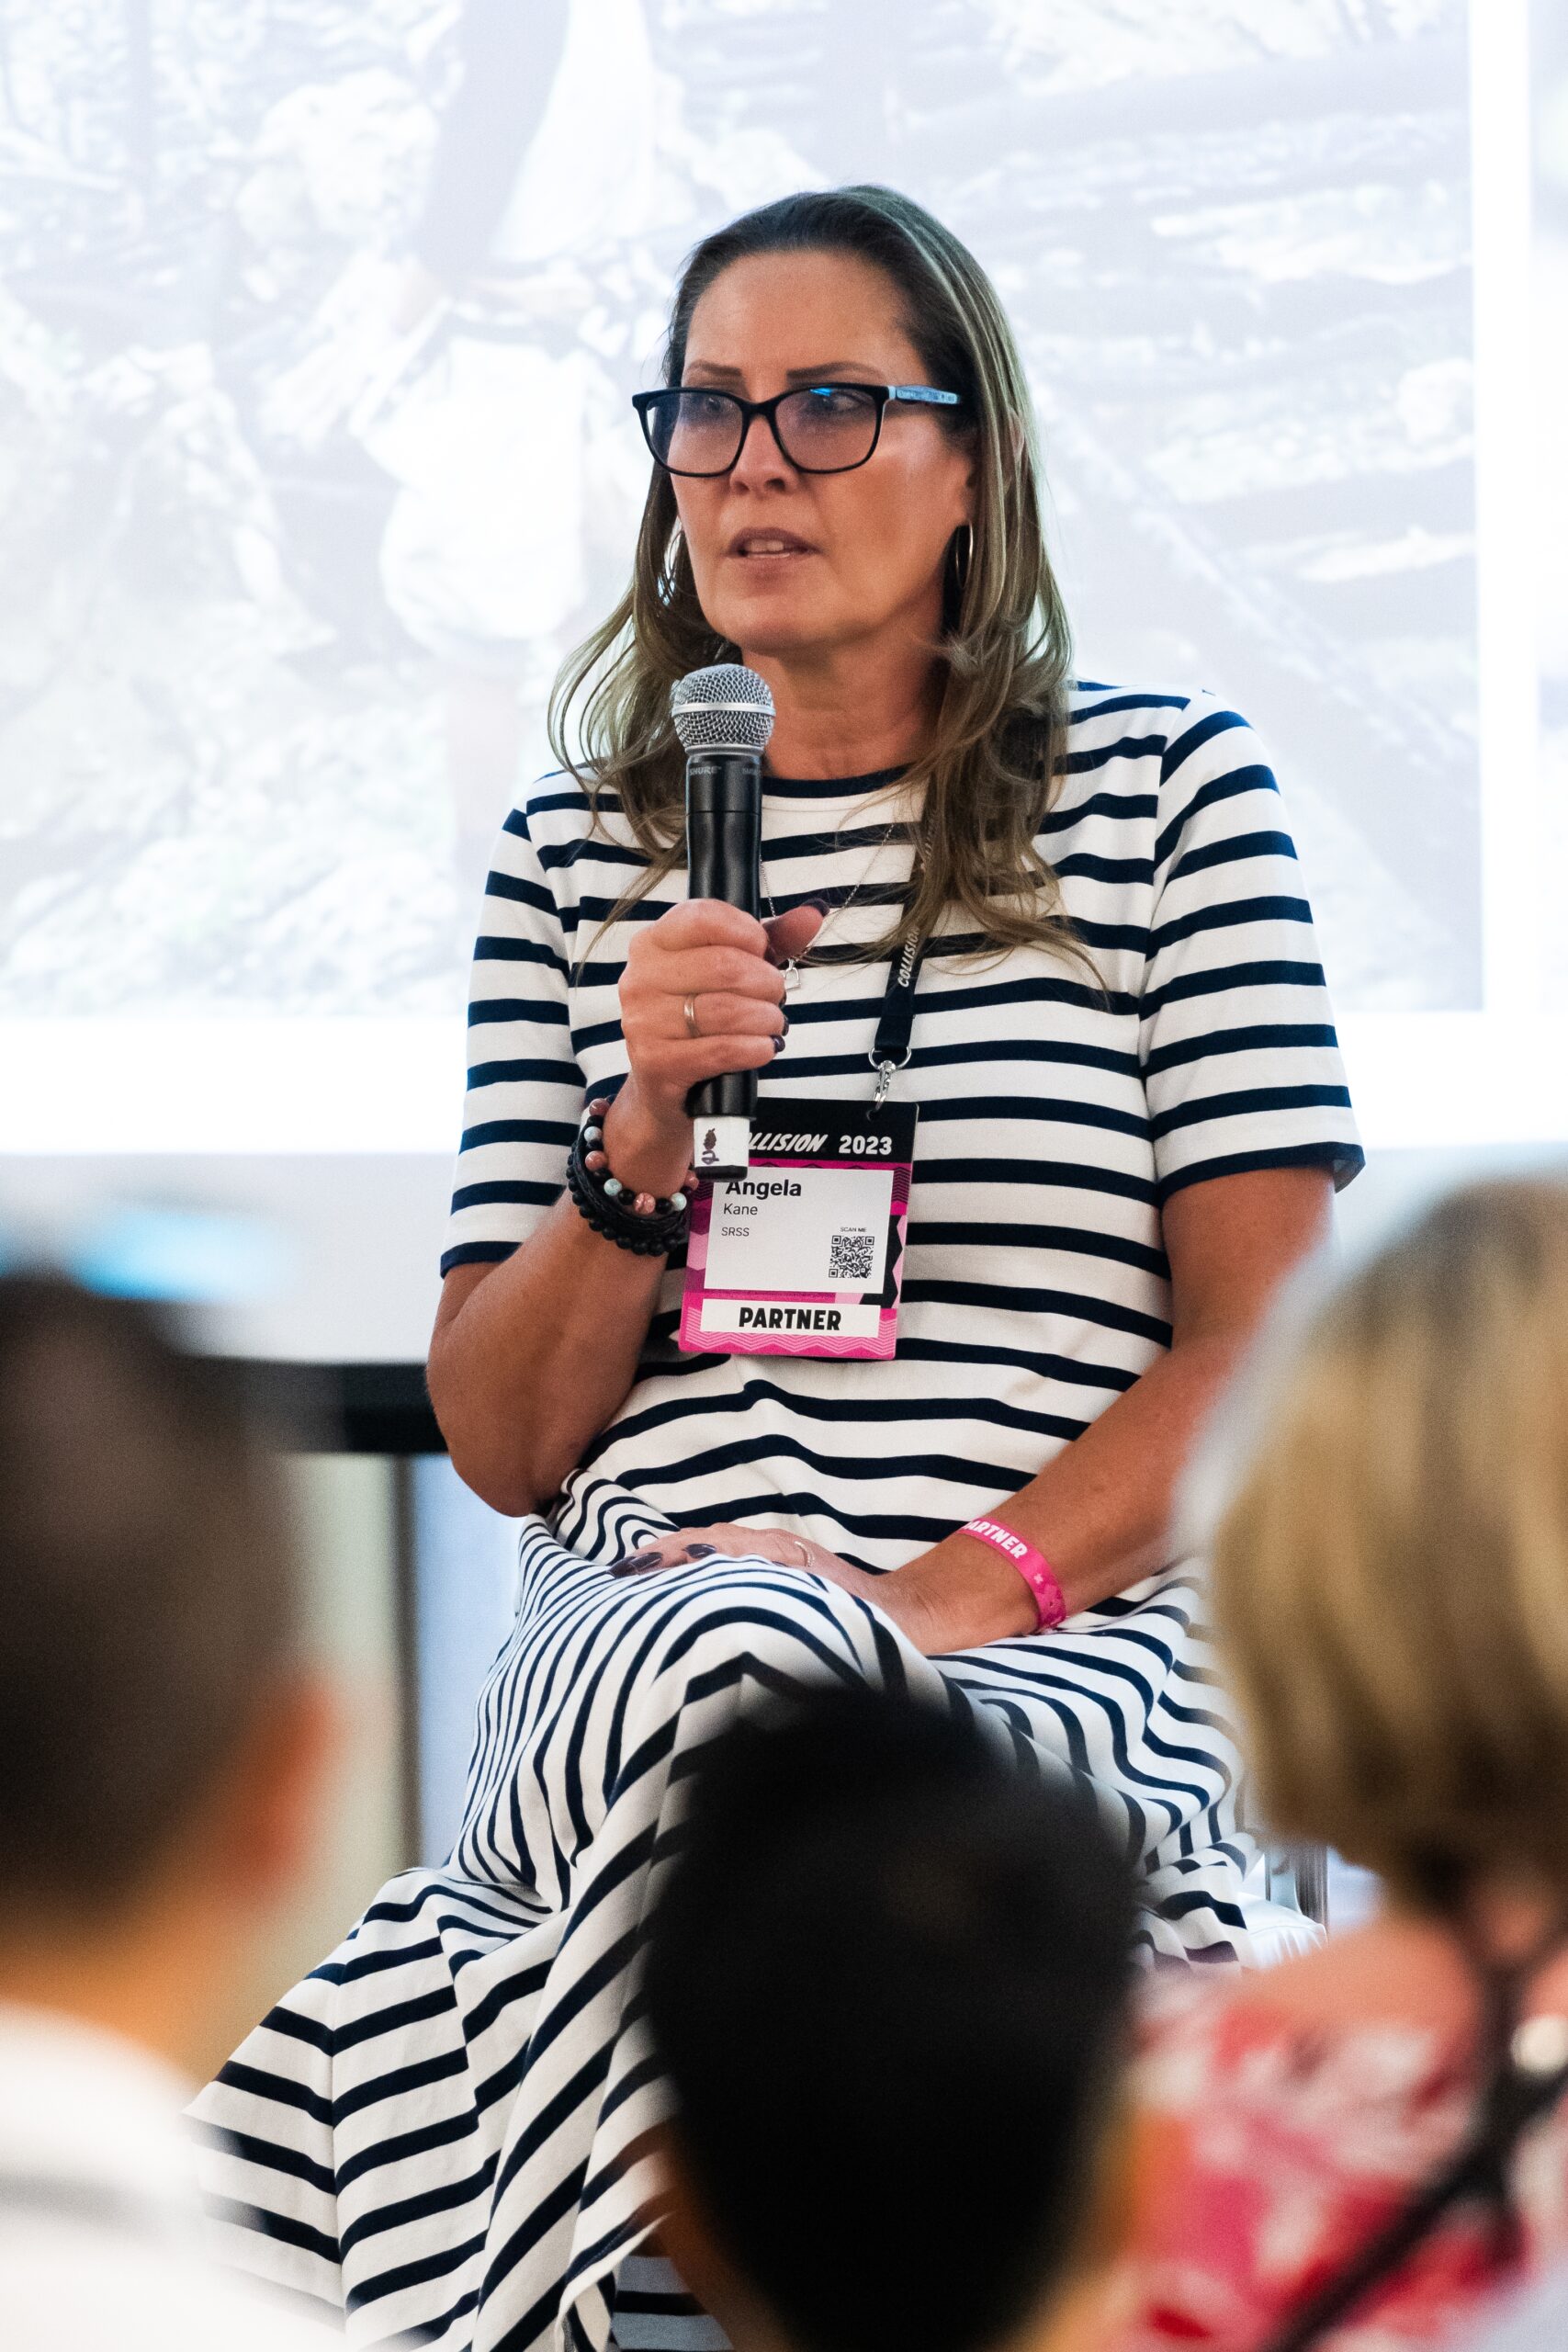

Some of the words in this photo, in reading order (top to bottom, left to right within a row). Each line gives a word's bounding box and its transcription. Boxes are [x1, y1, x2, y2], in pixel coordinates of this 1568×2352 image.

[748, 1132, 829, 1152] LLISION
[838, 1135, 893, 1155] 2023
[725, 1179, 802, 1200] Angela
[723, 1203, 758, 1215] Kane
[721, 1227, 750, 1238] SRSS
[739, 1307, 841, 1330] PARTNER
[963, 1521, 1028, 1558] ARTNER
